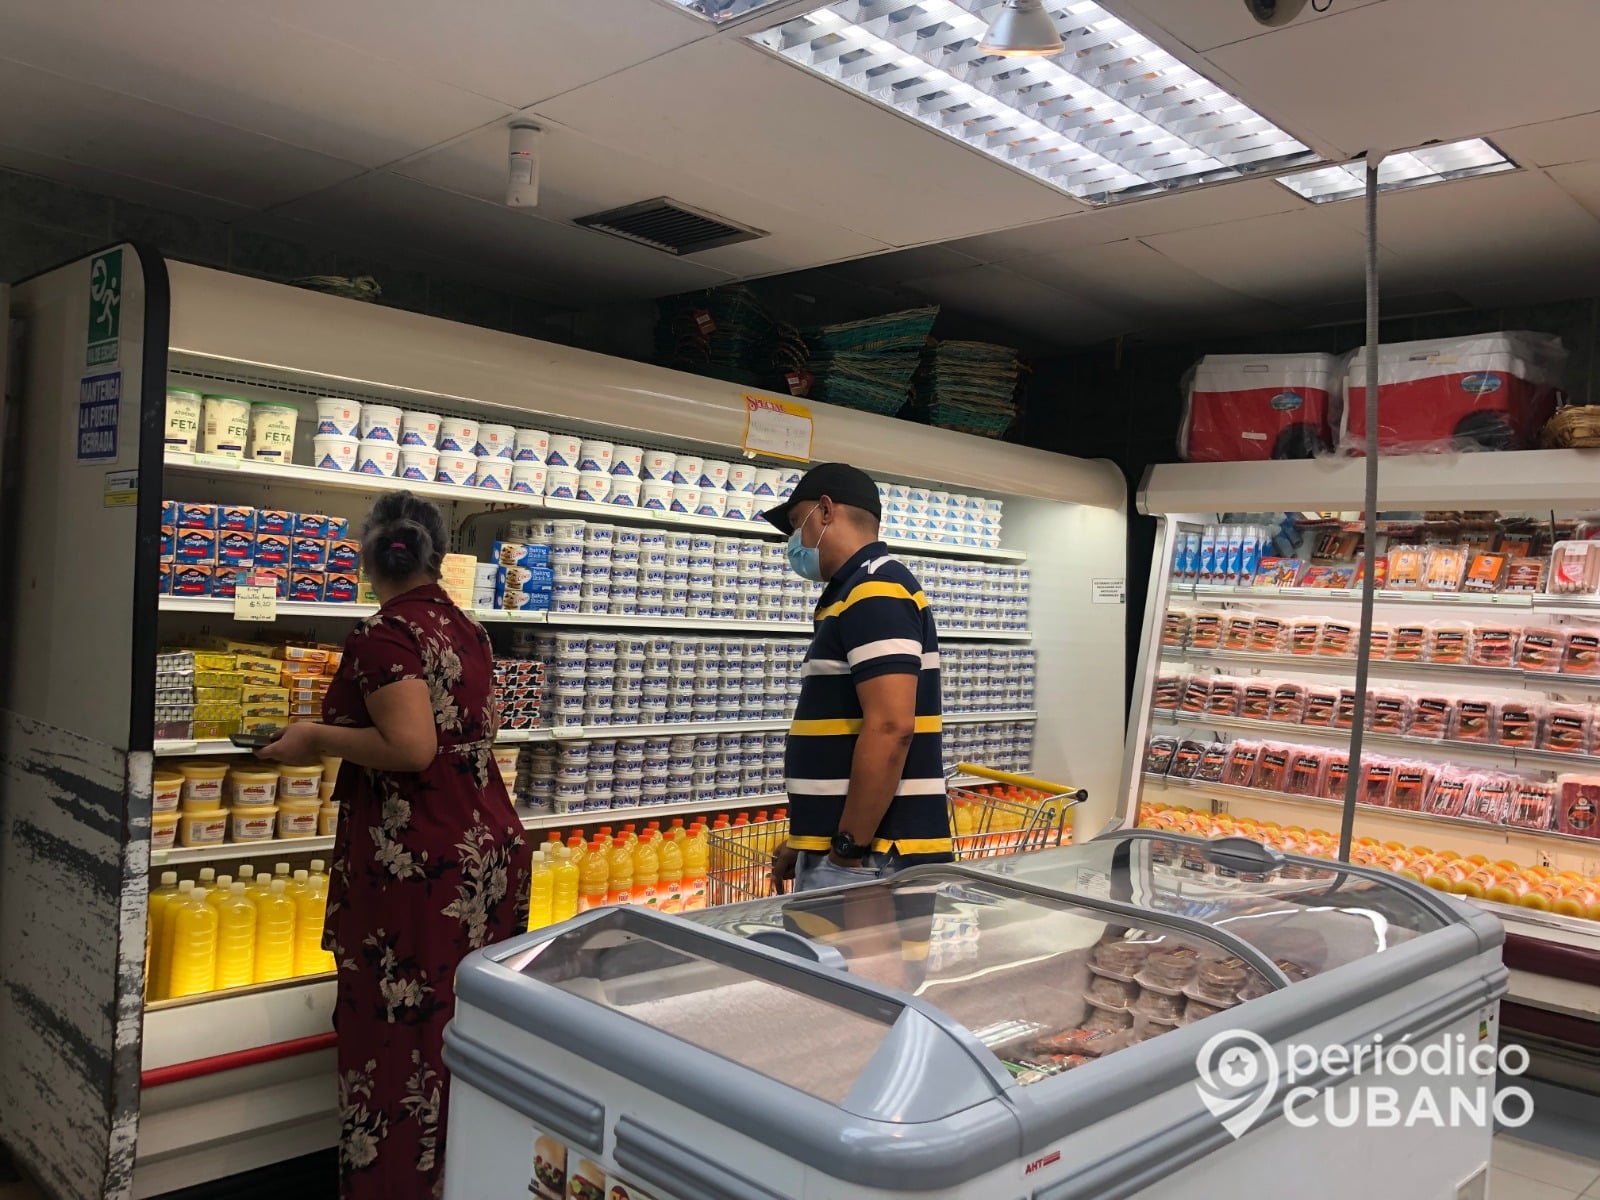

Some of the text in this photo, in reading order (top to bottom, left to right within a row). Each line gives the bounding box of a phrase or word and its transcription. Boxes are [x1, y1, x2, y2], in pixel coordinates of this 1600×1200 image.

[80, 378, 120, 403] MANTENGA
[80, 404, 117, 429] LA PUERTA
[170, 418, 197, 430] FETA
[81, 430, 114, 454] CERRADA
[265, 431, 291, 443] FETA
[1025, 1158, 1043, 1175] AHT
